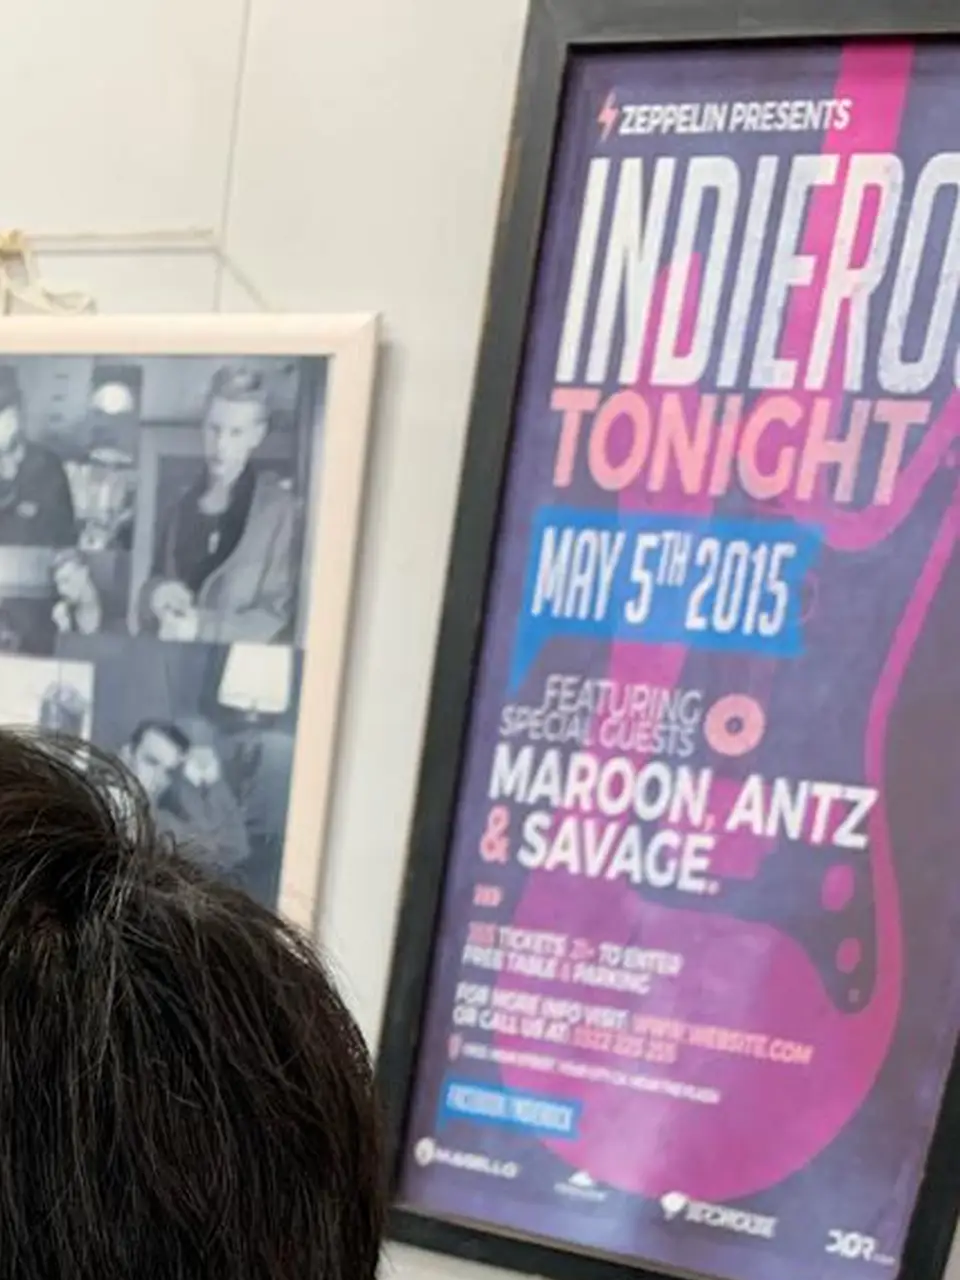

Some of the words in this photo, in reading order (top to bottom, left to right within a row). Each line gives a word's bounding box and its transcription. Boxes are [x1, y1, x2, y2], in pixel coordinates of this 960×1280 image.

[619, 102, 727, 135] ZEPPELIN
[729, 98, 852, 133] PRESENTS
[554, 152, 960, 394] INDIERO
[550, 388, 931, 506] TONIGHT
[531, 526, 626, 621] MAY
[624, 530, 690, 625] 5TH
[685, 539, 796, 636] 2015
[500, 705, 594, 747] SPECIAL
[597, 717, 696, 757] GUESTS
[542, 673, 703, 725] FEATURING
[489, 742, 715, 832] MAROON,
[726, 774, 879, 849] ANTZ
[479, 804, 510, 862] &
[517, 814, 719, 894] SAVAGE.
